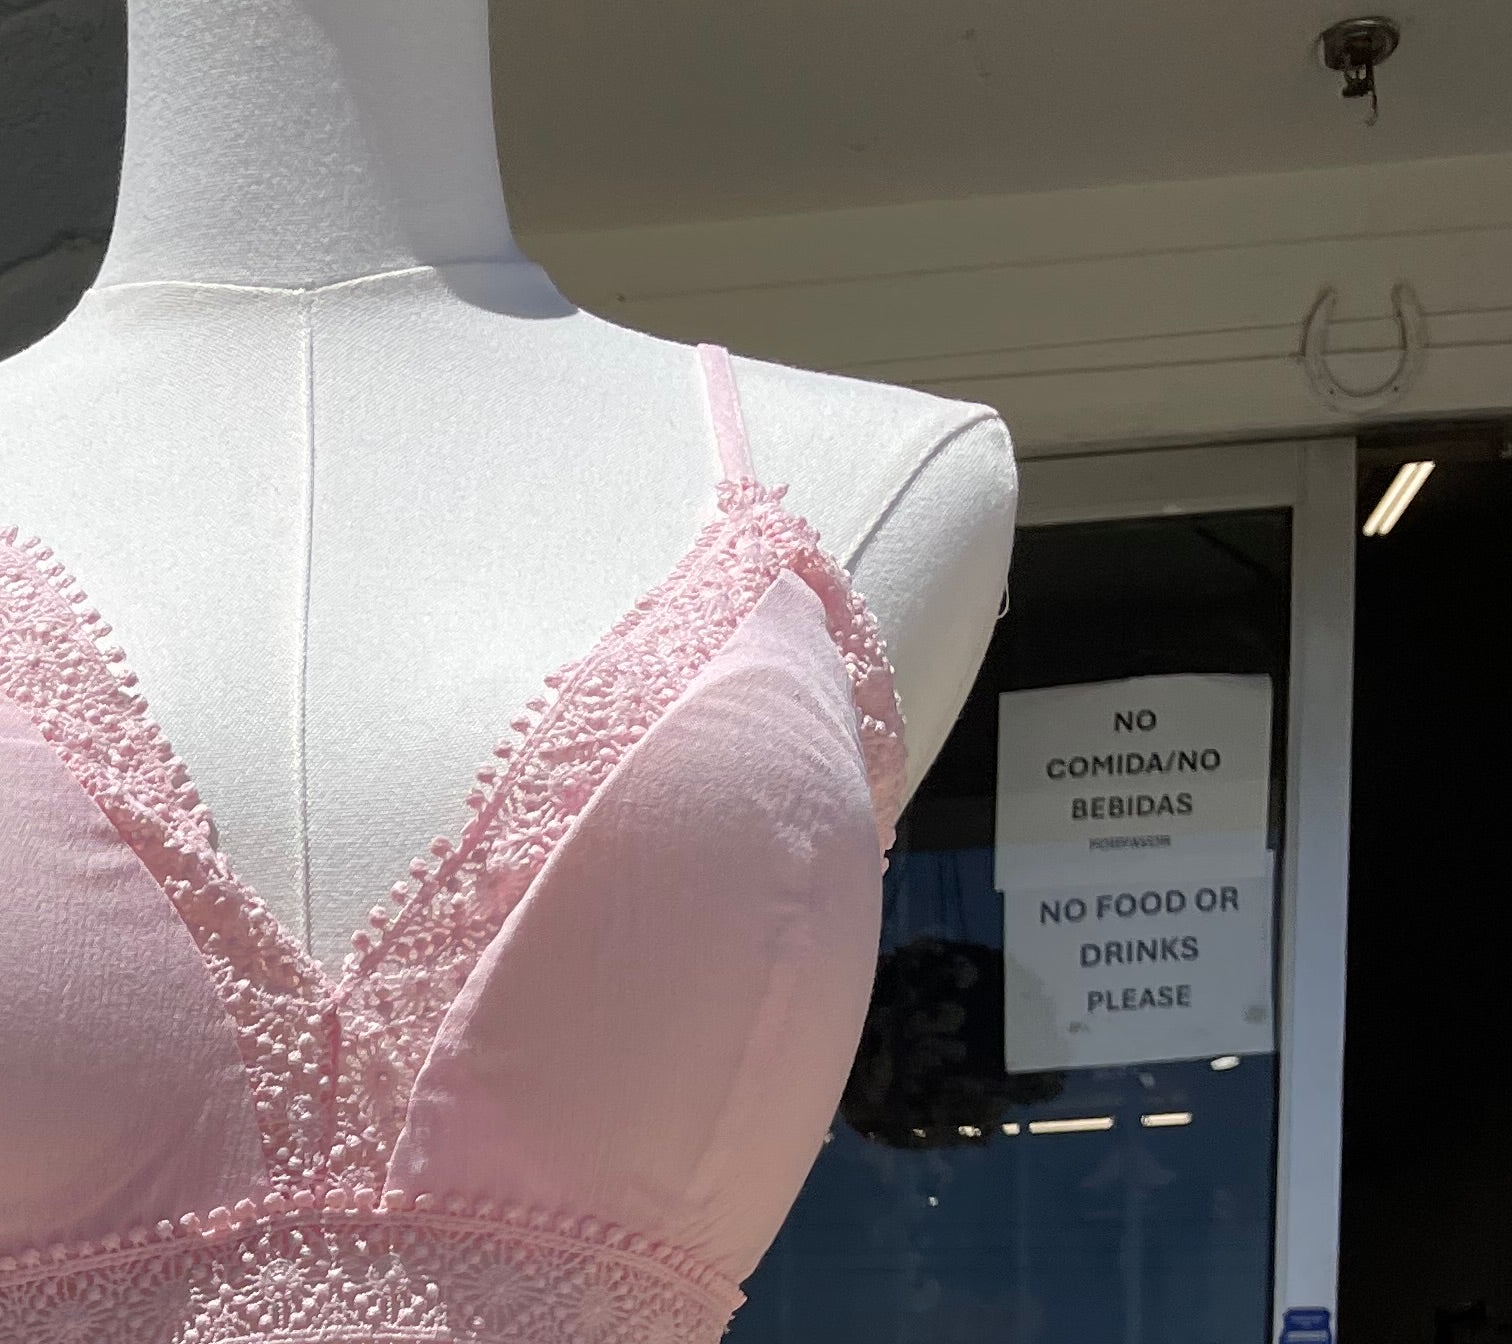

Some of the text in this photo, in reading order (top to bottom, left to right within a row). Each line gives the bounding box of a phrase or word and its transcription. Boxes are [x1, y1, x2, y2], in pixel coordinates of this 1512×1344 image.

[1114, 709, 1157, 732] NO
[1046, 748, 1221, 780] COMIDA/NO
[1071, 793, 1193, 820] BEBIDAS
[1039, 886, 1239, 926] NO FOOD OR
[1080, 937, 1199, 968] DRINKS
[1088, 985, 1192, 1013] PLEASE
